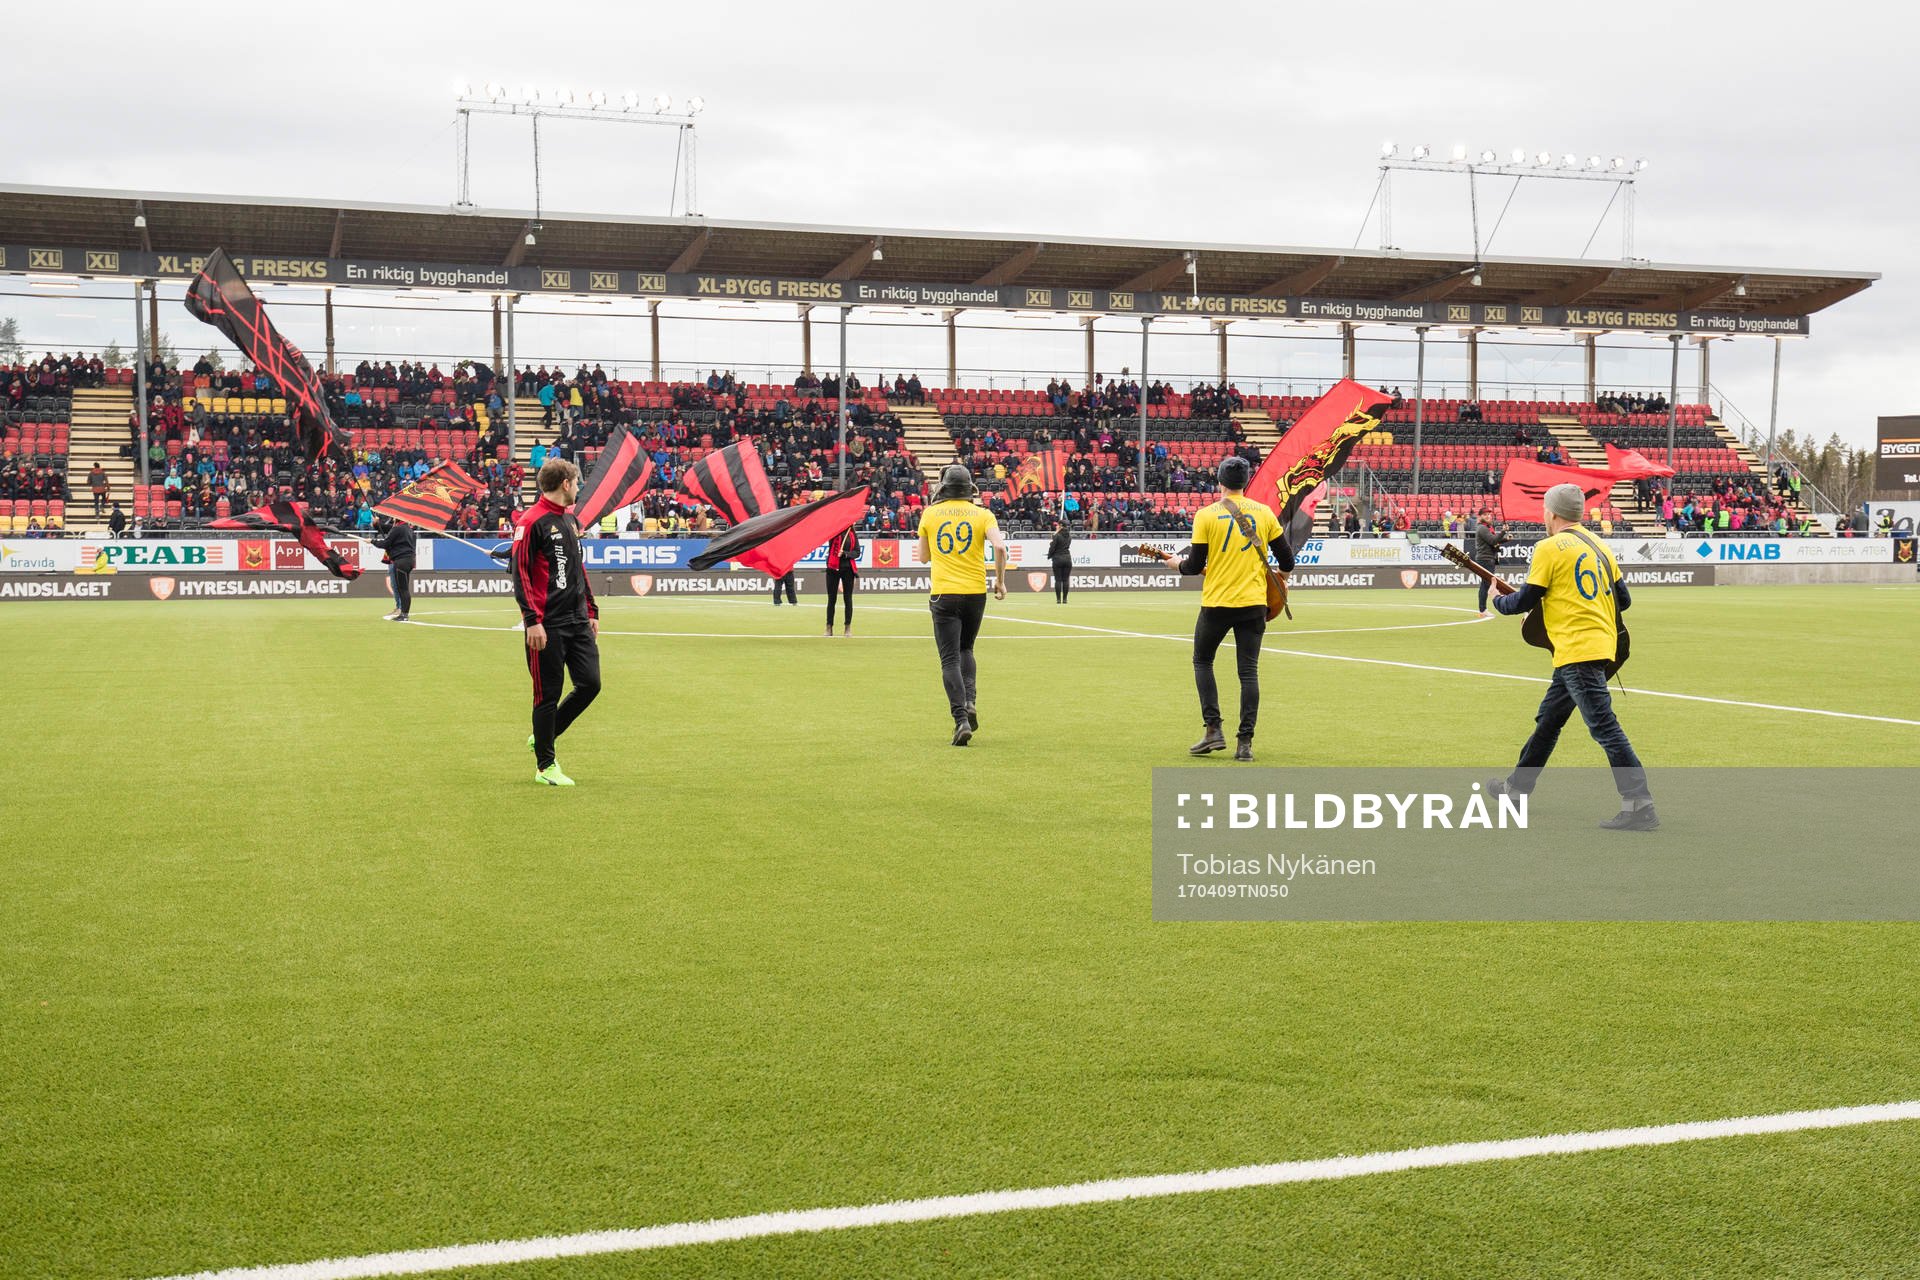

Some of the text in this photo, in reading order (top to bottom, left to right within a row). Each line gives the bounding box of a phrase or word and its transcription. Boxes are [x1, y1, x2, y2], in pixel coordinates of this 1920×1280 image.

[158, 256, 328, 278] XL-BG FRESKS
[347, 264, 508, 286] En riktig bygghandel
[698, 278, 842, 298] XL-BYGG FRESKS
[859, 285, 998, 304] En riktig bygghandel
[1162, 296, 1287, 313] XL-BYGG FRESKS
[1301, 302, 1423, 319] En riktig bygghandel
[1566, 310, 1678, 327] XL-BYGG FRESKS
[1690, 315, 1799, 331] En riktig bygghandel
[936, 521, 973, 555] 69
[103, 545, 207, 565] PEAB
[276, 545, 303, 558] App
[582, 545, 677, 565] LARIS
[1073, 553, 1091, 565] vida
[1719, 543, 1781, 560] INAB
[11, 556, 55, 568] bravida
[179, 579, 350, 597] HYRESLANDSLAGET
[413, 579, 515, 594] HYRESLAND
[656, 577, 805, 592] HYRESLANDSLAT
[1287, 573, 1375, 587] SLANDSLAGET
[0, 581, 112, 597] ANDSLAGET
